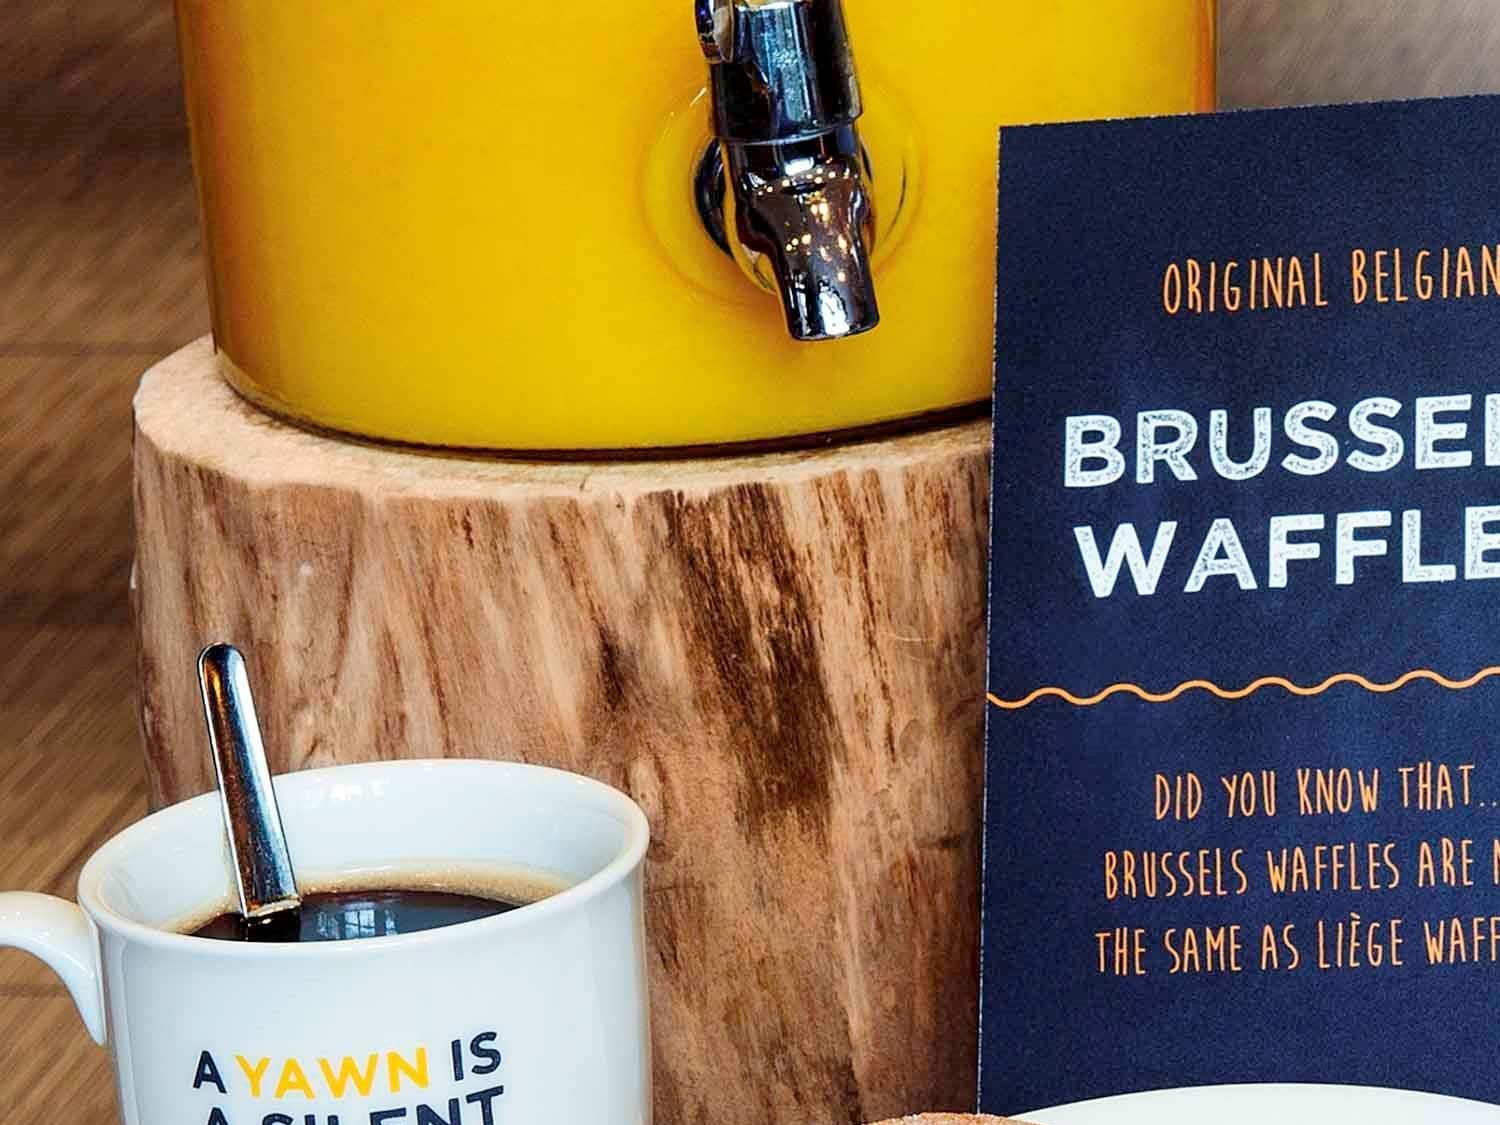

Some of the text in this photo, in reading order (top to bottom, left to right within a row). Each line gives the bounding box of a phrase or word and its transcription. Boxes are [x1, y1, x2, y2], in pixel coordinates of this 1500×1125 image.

[1163, 252, 1328, 315] ORIGINAL
[1155, 773, 1203, 821] DID
[1222, 769, 1277, 818] YOU
[1297, 766, 1379, 816] KNOW
[1104, 847, 1248, 900] BRUSSELS
[1266, 843, 1400, 894] WAFFLES
[1418, 838, 1473, 888] ARE
[1096, 929, 1146, 977] THE
[1163, 924, 1242, 974] SAME
[1260, 923, 1300, 971] AS
[1316, 912, 1403, 970] LIÈGE
[192, 1031, 502, 1101] A YAWN IS
